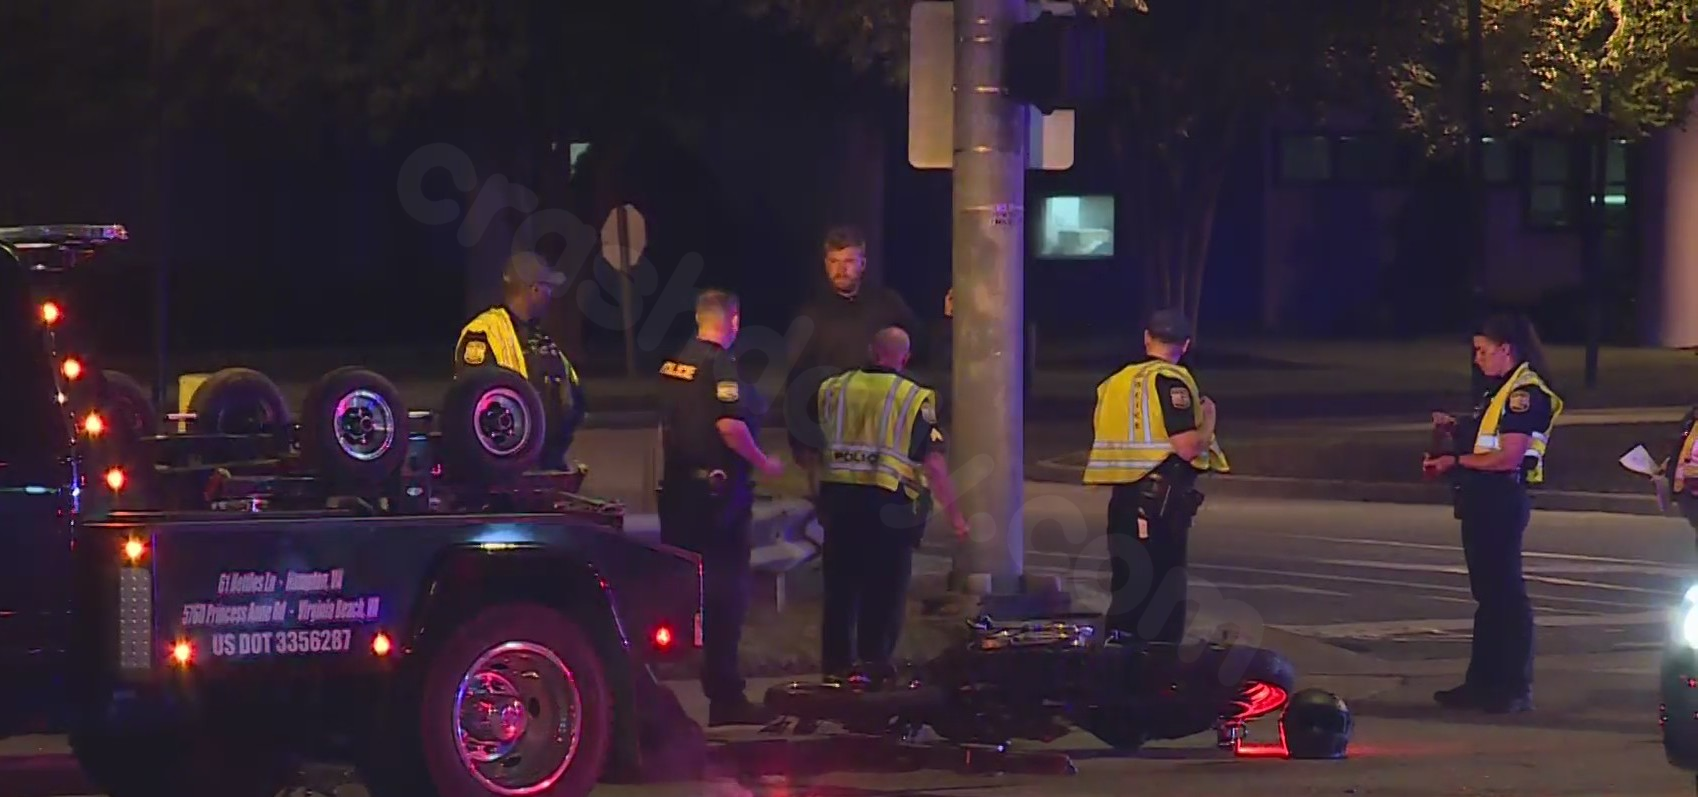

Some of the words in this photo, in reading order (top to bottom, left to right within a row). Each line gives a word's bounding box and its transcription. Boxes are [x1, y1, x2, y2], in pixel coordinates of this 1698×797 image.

[212, 634, 236, 656] US
[239, 633, 272, 655] DOT
[275, 629, 351, 654] 3356287
